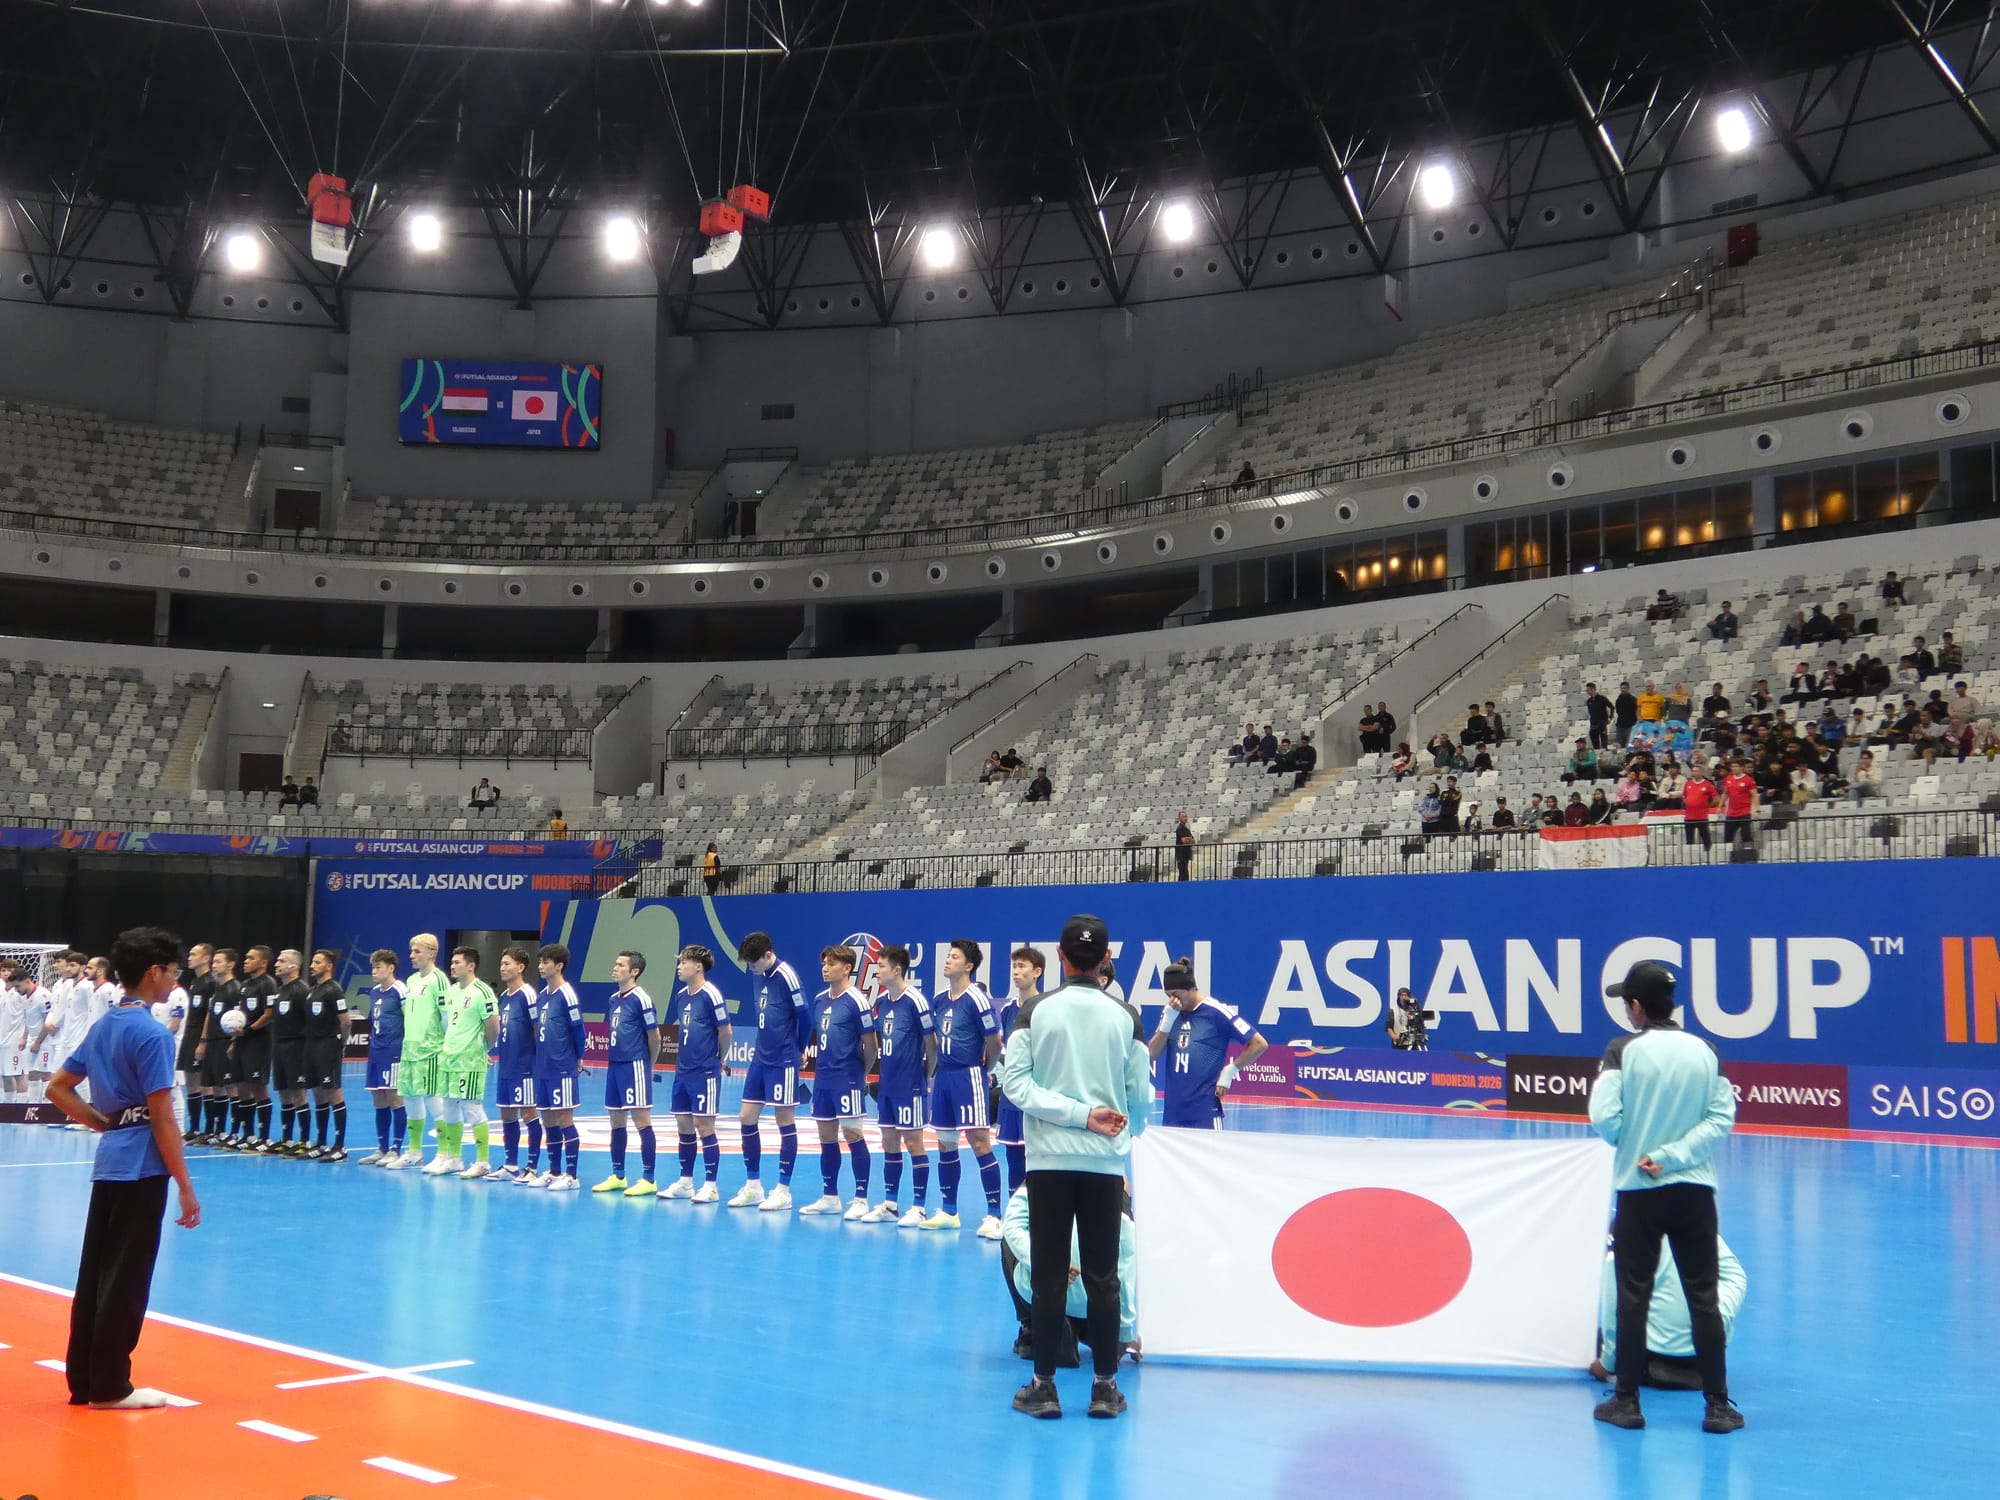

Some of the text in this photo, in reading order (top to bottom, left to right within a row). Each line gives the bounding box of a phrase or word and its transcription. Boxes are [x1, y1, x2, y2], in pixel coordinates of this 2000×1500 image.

[373, 842, 420, 853] FUTSAL
[421, 843, 458, 854] ASIAN
[459, 844, 484, 854] CUP
[353, 874, 422, 889] FUTSAL
[424, 874, 483, 889] ASIAN
[484, 873, 524, 890] CUP
[1258, 938, 1582, 1034] ASIAN
[452, 1012, 458, 1026] 2
[759, 1012, 765, 1029] 8
[502, 1028, 507, 1042] 3
[539, 1027, 545, 1042] 5
[610, 1031, 617, 1047] 6
[683, 1029, 689, 1046] 7
[819, 1034, 827, 1051] 9
[882, 1038, 893, 1056] 10
[941, 1036, 951, 1055] 11
[12, 1056, 19, 1066] 9
[42, 1052, 48, 1062] 8
[1175, 1053, 1190, 1074] 14
[382, 1070, 390, 1084] 4
[422, 1076, 427, 1089] 1
[1248, 1073, 1286, 1083] to Arabia
[1303, 1066, 1503, 1089] FUTSAL ASIAN CUP INDONESIA 2026
[1514, 1074, 1588, 1095] NEOM
[459, 1079, 466, 1093] 2
[774, 1084, 783, 1100] 8
[515, 1087, 522, 1102] 3
[553, 1089, 561, 1105] 5
[626, 1088, 634, 1104] 6
[1748, 1083, 1842, 1107] AIRWAYS
[1871, 1083, 1995, 1120] SAISO
[697, 1095, 705, 1111] 7
[841, 1095, 850, 1113] 9
[25, 1106, 39, 1121] AFC
[898, 1107, 912, 1125] 10
[960, 1105, 973, 1123] 11
